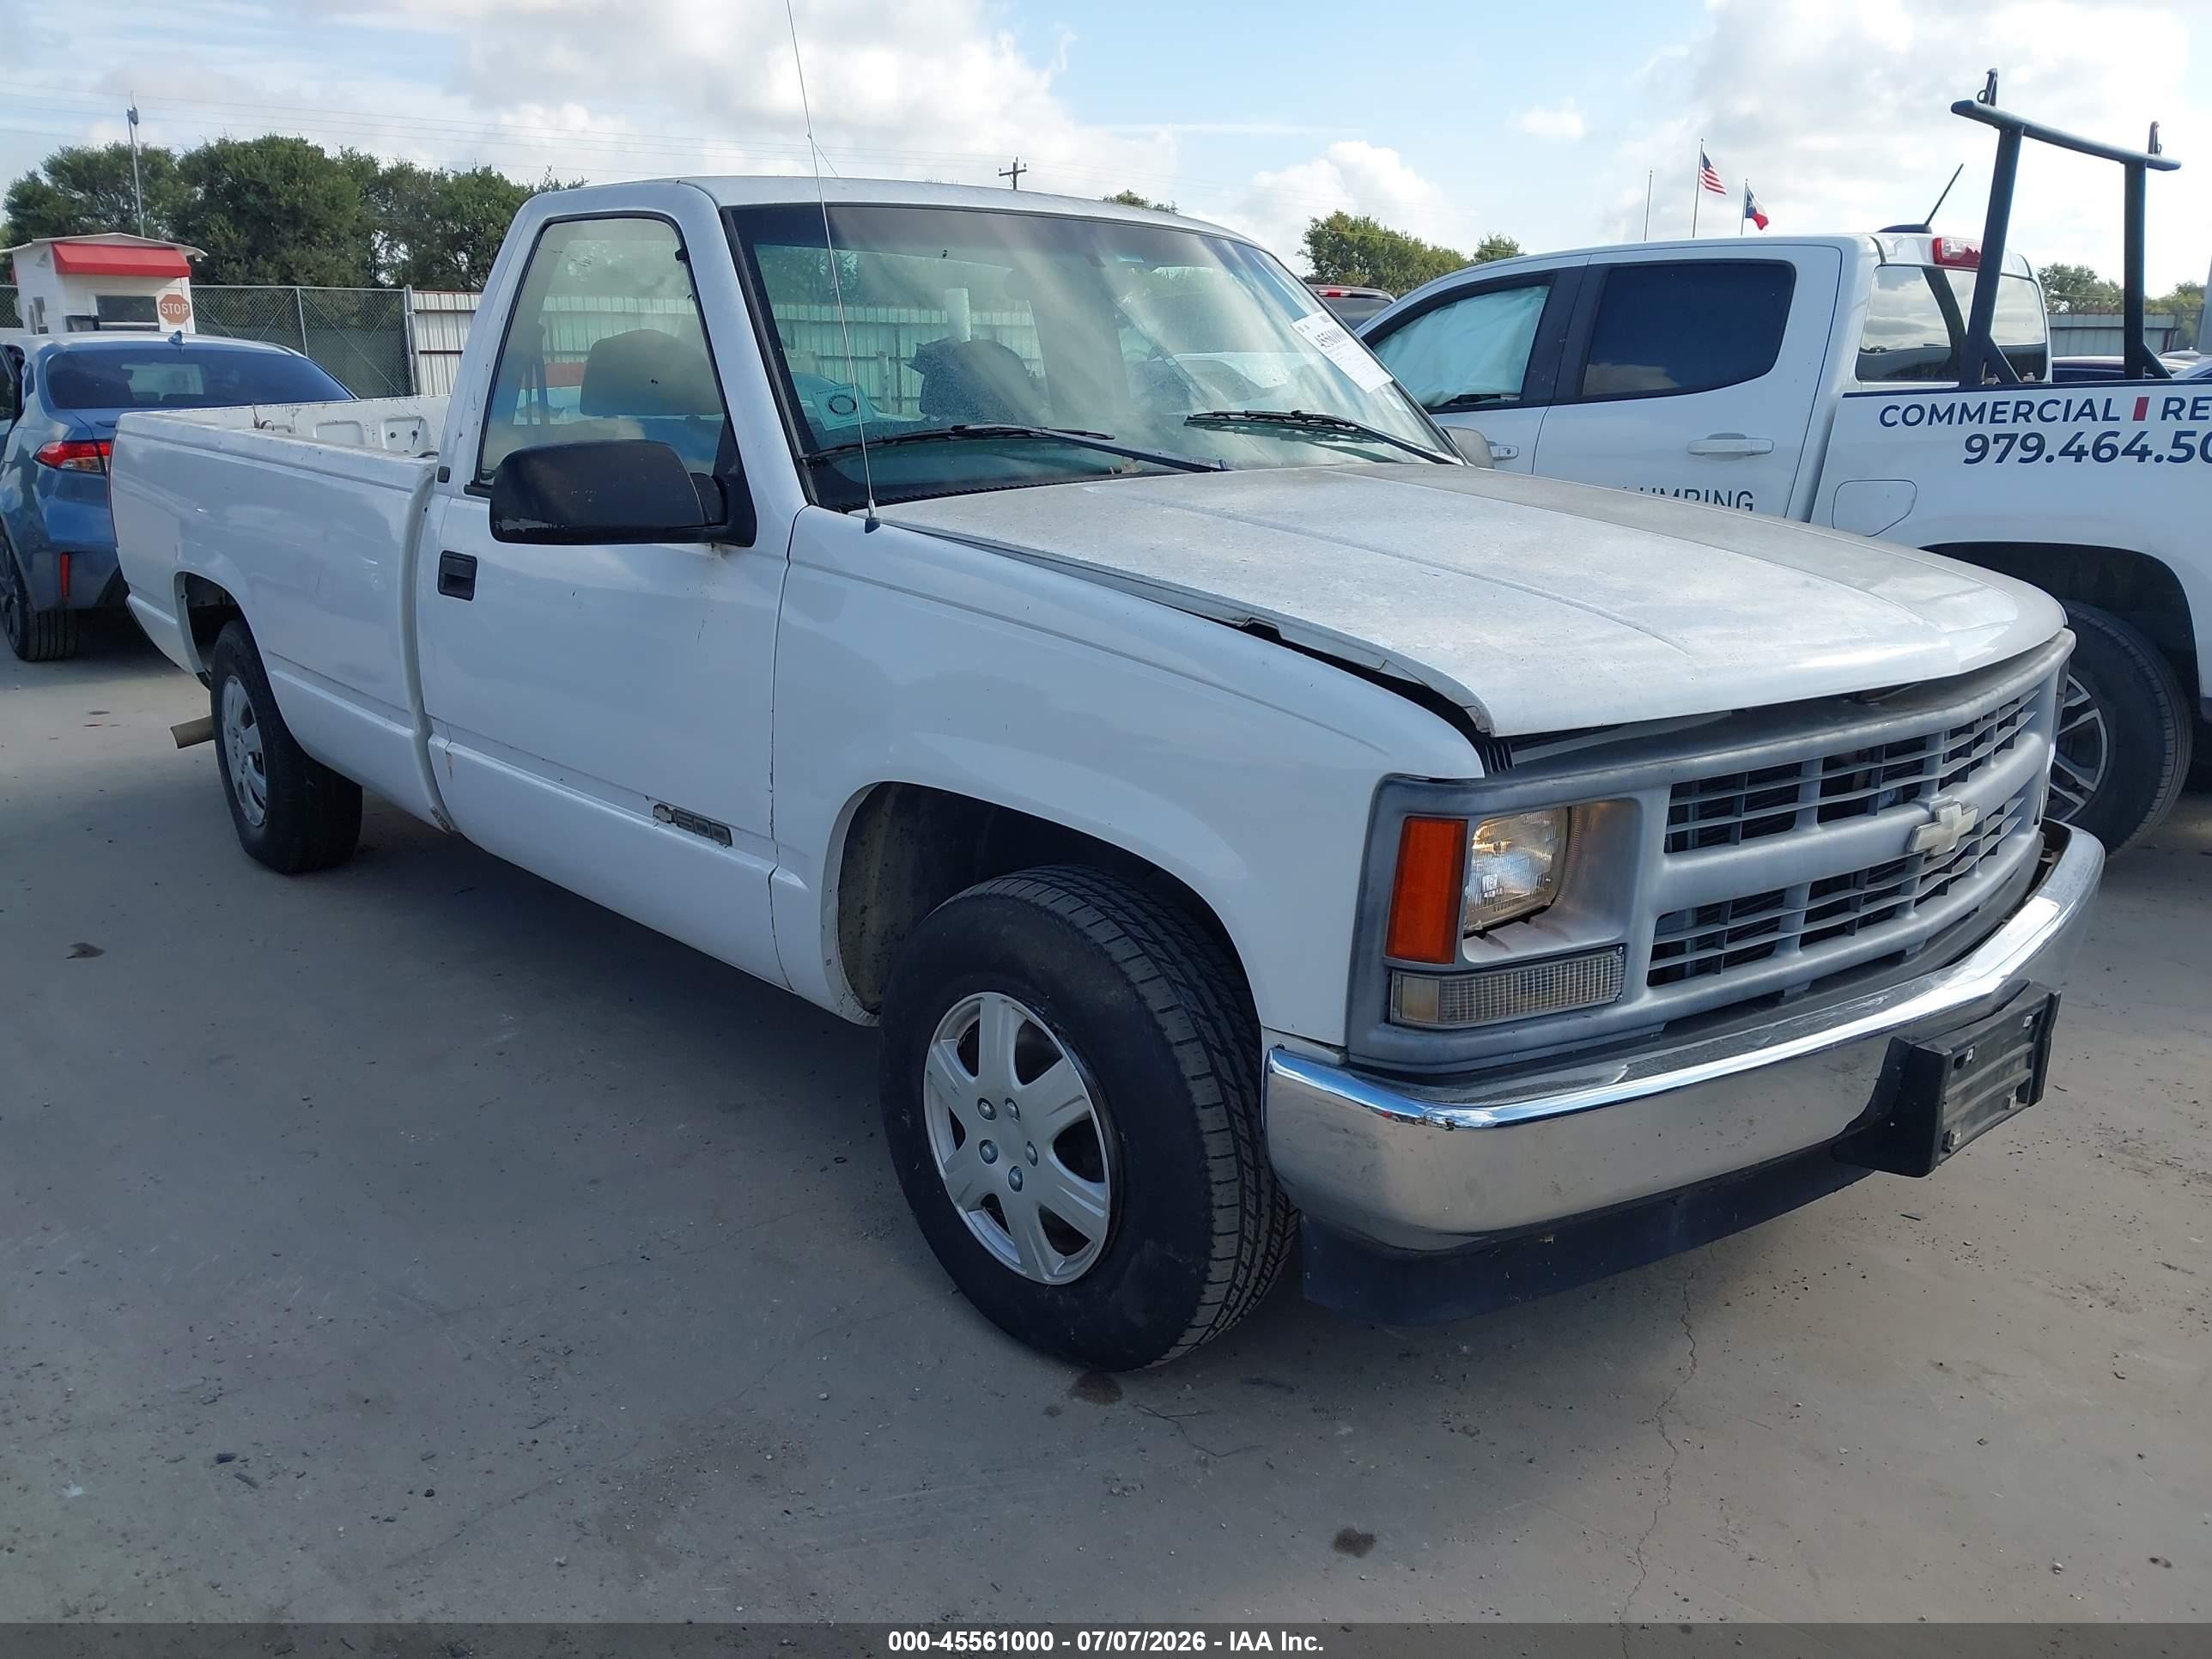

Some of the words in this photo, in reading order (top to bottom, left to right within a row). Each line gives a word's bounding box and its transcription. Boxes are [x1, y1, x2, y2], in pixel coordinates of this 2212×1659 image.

[161, 302, 189, 315] STOP
[1879, 398, 2121, 428] COMMERCIAL
[2160, 396, 2212, 422] RE
